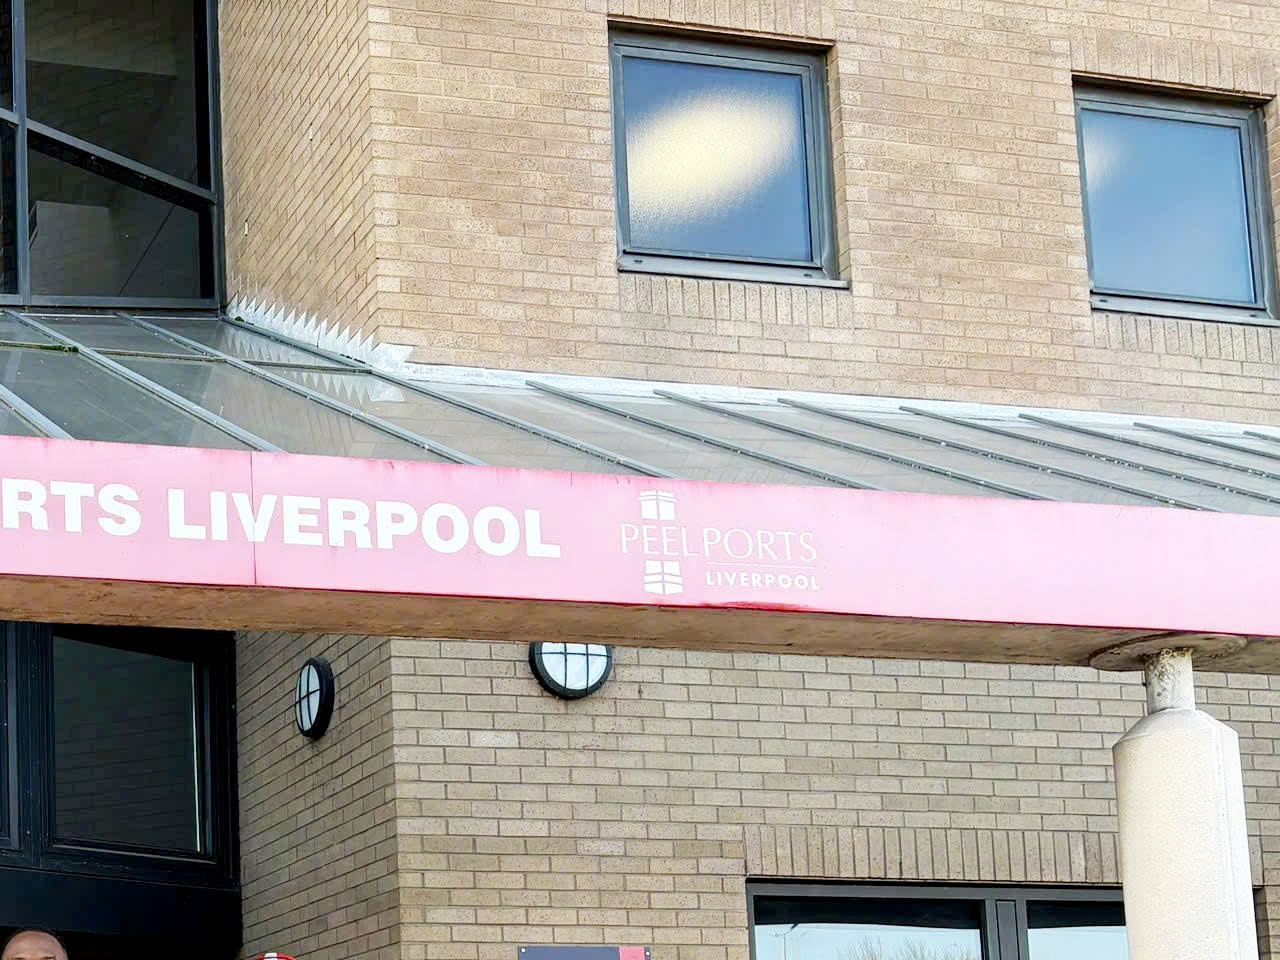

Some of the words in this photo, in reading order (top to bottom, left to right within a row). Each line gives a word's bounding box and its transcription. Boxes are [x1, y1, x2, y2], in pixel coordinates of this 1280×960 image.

[167, 488, 561, 558] LIVERPOOL
[620, 523, 699, 557] PEEL
[702, 527, 817, 562] PORTS
[705, 571, 820, 590] LIVERPOOL
